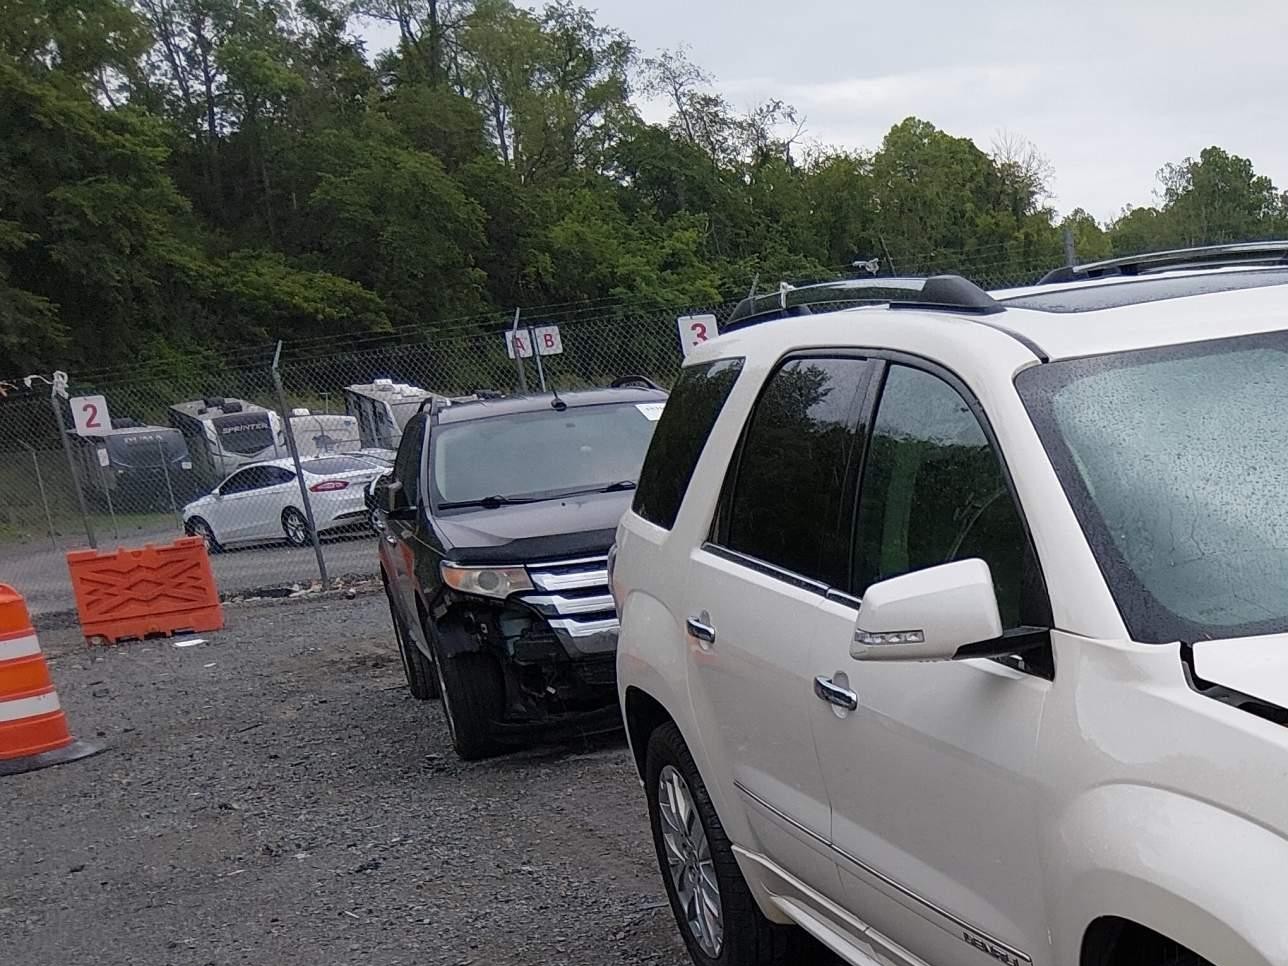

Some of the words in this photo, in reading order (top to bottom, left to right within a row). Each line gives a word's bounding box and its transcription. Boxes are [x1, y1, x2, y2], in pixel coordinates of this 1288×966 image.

[543, 333, 555, 348] B
[690, 322, 708, 347] 3
[82, 403, 102, 428] 2
[222, 422, 269, 434] SPRINTER
